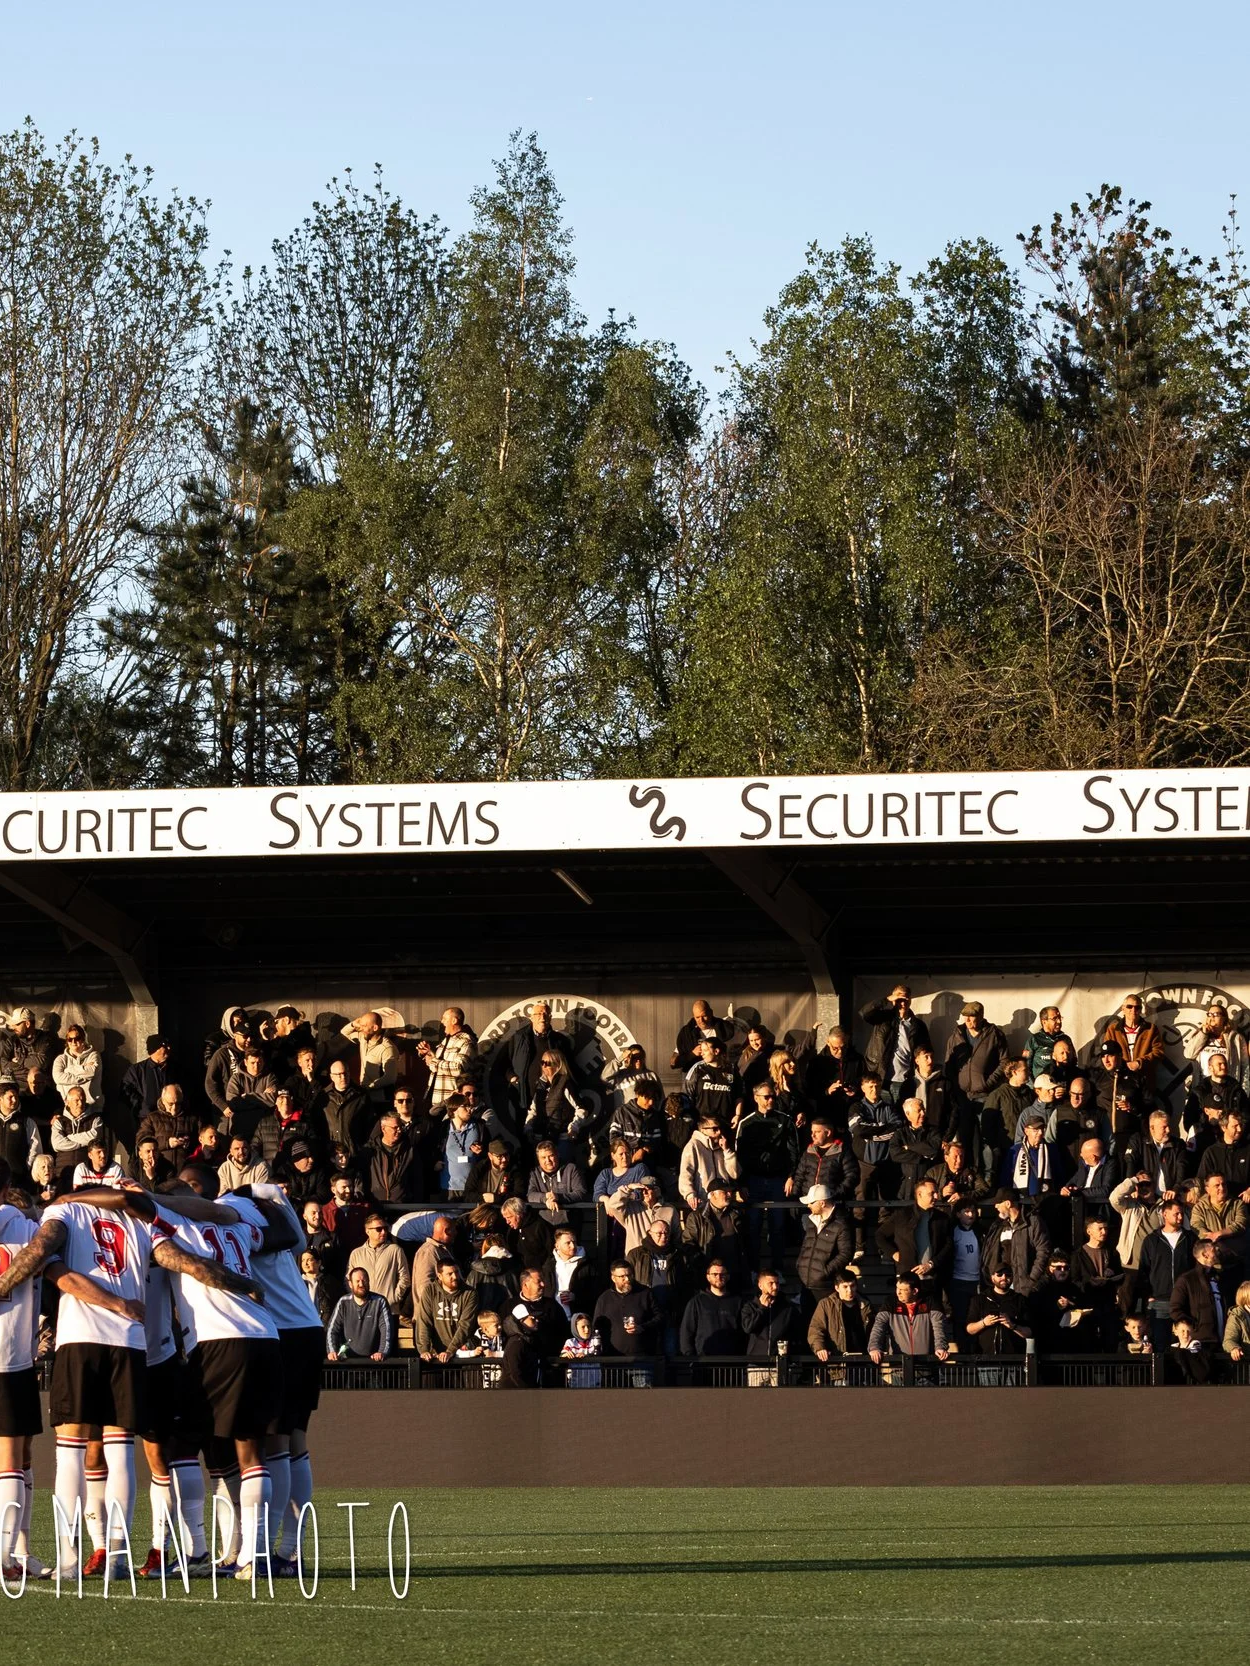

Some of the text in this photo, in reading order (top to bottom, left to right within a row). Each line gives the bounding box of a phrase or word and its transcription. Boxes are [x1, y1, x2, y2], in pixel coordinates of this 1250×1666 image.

[268, 792, 500, 849] SYSTEMS
[739, 783, 1019, 840] SECURITEC
[1082, 776, 1250, 833] SYSTE
[91, 1216, 128, 1277] 9
